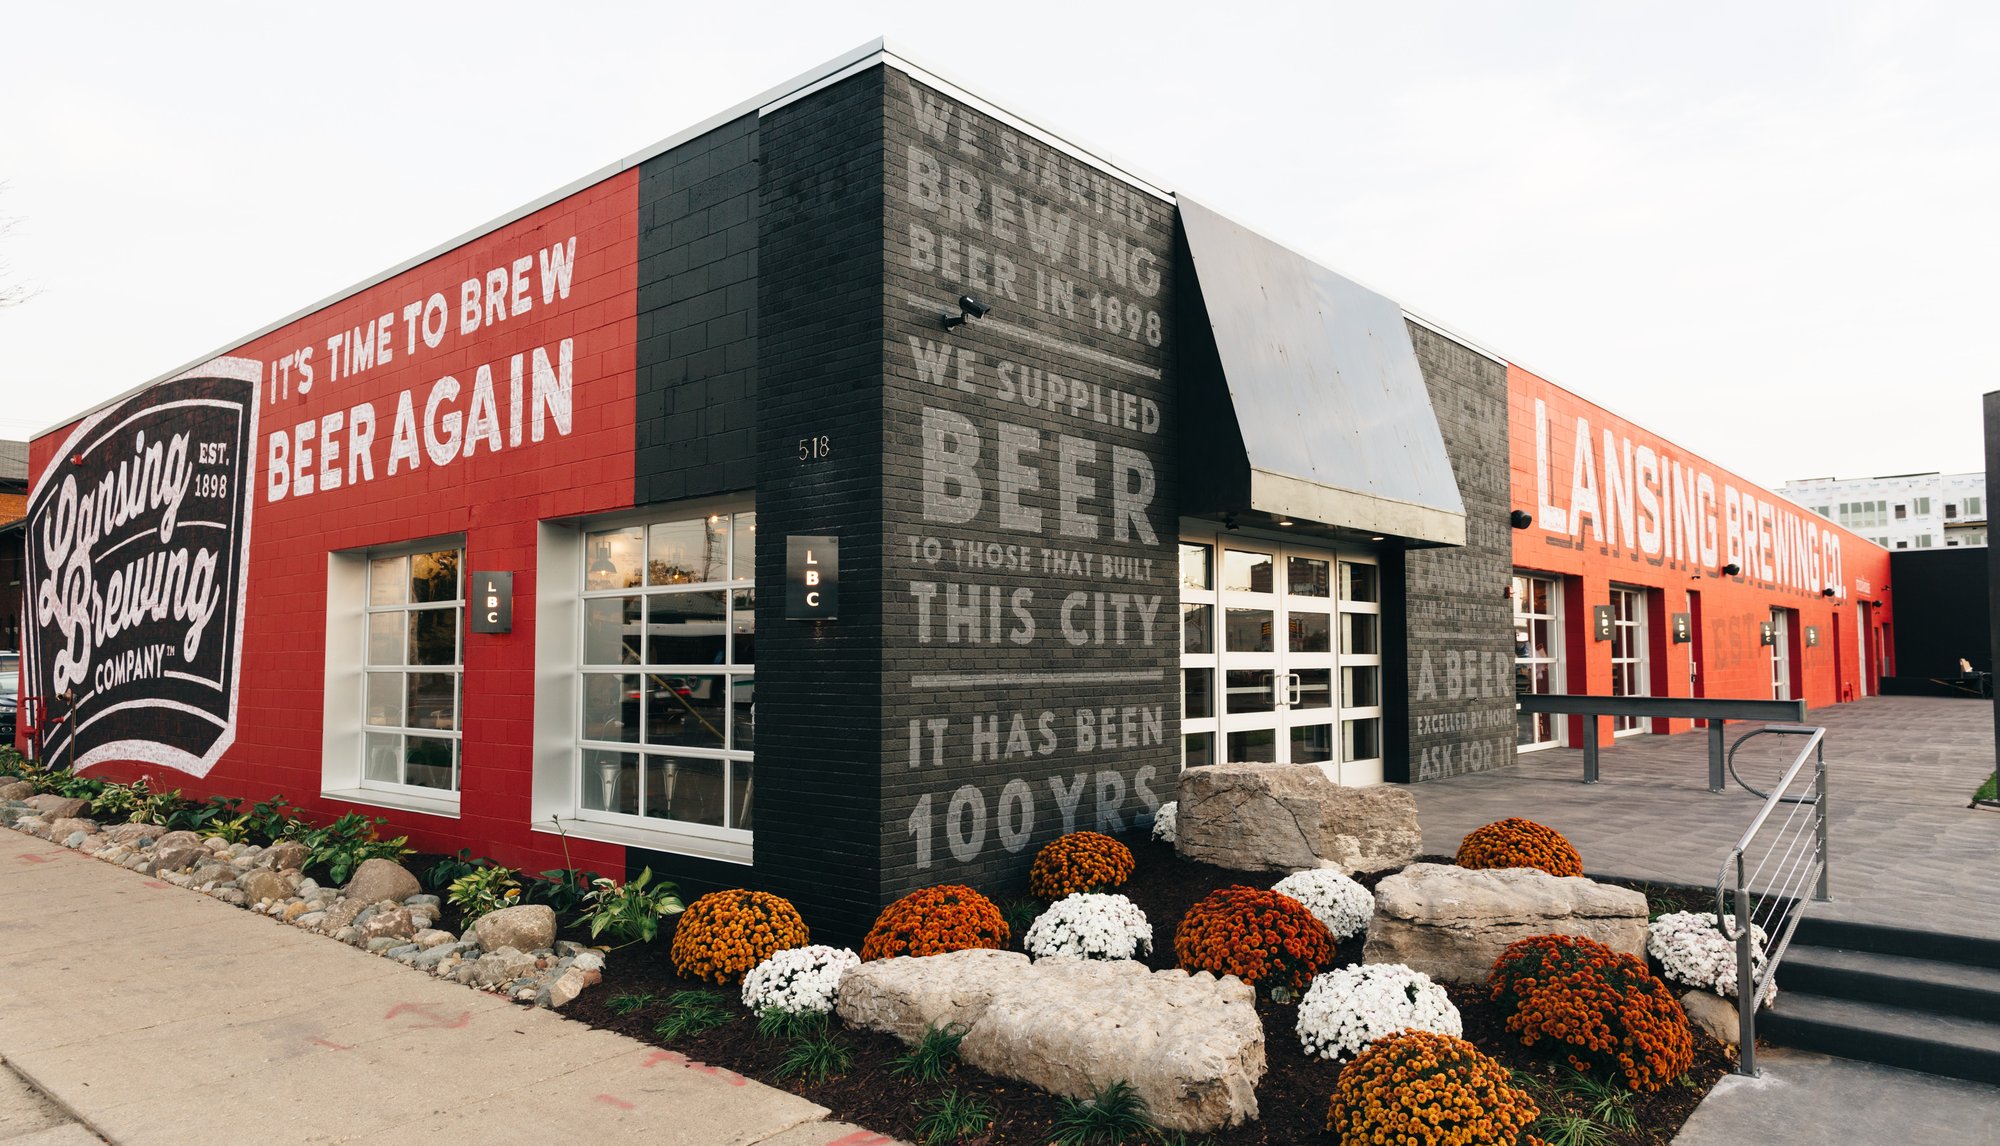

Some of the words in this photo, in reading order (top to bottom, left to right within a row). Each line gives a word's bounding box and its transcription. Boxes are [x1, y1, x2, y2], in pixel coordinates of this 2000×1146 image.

[906, 80, 978, 155] WE
[1001, 131, 1148, 231] STARTED
[908, 145, 1161, 297] BREWING
[270, 346, 314, 404] IT'S
[327, 313, 394, 382] TIME
[403, 292, 447, 355] TO
[460, 236, 577, 336] BREW
[909, 223, 1018, 302] BEER
[1036, 269, 1074, 320] IN
[1090, 293, 1162, 347] 1898
[268, 403, 374, 502] BEER
[388, 338, 573, 476] AGAIN
[908, 335, 975, 394] WE
[997, 360, 1161, 434] SUPPLIED
[195, 474, 227, 499] 1898
[198, 442, 230, 466] EST.
[799, 435, 830, 461] 518
[923, 406, 1160, 545] BEER
[1535, 397, 1718, 569] LANSING
[1725, 484, 1820, 593] BREWING
[1822, 529, 1847, 600] CO.
[39, 430, 193, 637] Lansing
[907, 535, 942, 564] TO
[952, 538, 1031, 571] THOSE
[1041, 548, 1093, 577] THAT
[1102, 555, 1153, 581] BUILT
[53, 547, 221, 696] Brewing
[910, 581, 1036, 645] THIS
[1060, 591, 1162, 646] CITY
[1416, 649, 1438, 700] A
[1447, 650, 1510, 700] BEER
[1417, 712, 1468, 736] EXCELLED
[1471, 711, 1485, 729] BY
[1486, 708, 1512, 727] NONE
[909, 718, 948, 768] IT
[972, 711, 1058, 762] HAS
[1076, 706, 1163, 752] BEEN
[1418, 744, 1453, 782] ASK
[1461, 739, 1493, 774] FOR
[1499, 736, 1513, 766] IT
[908, 778, 1035, 870] 100
[1048, 765, 1160, 834] YRS
